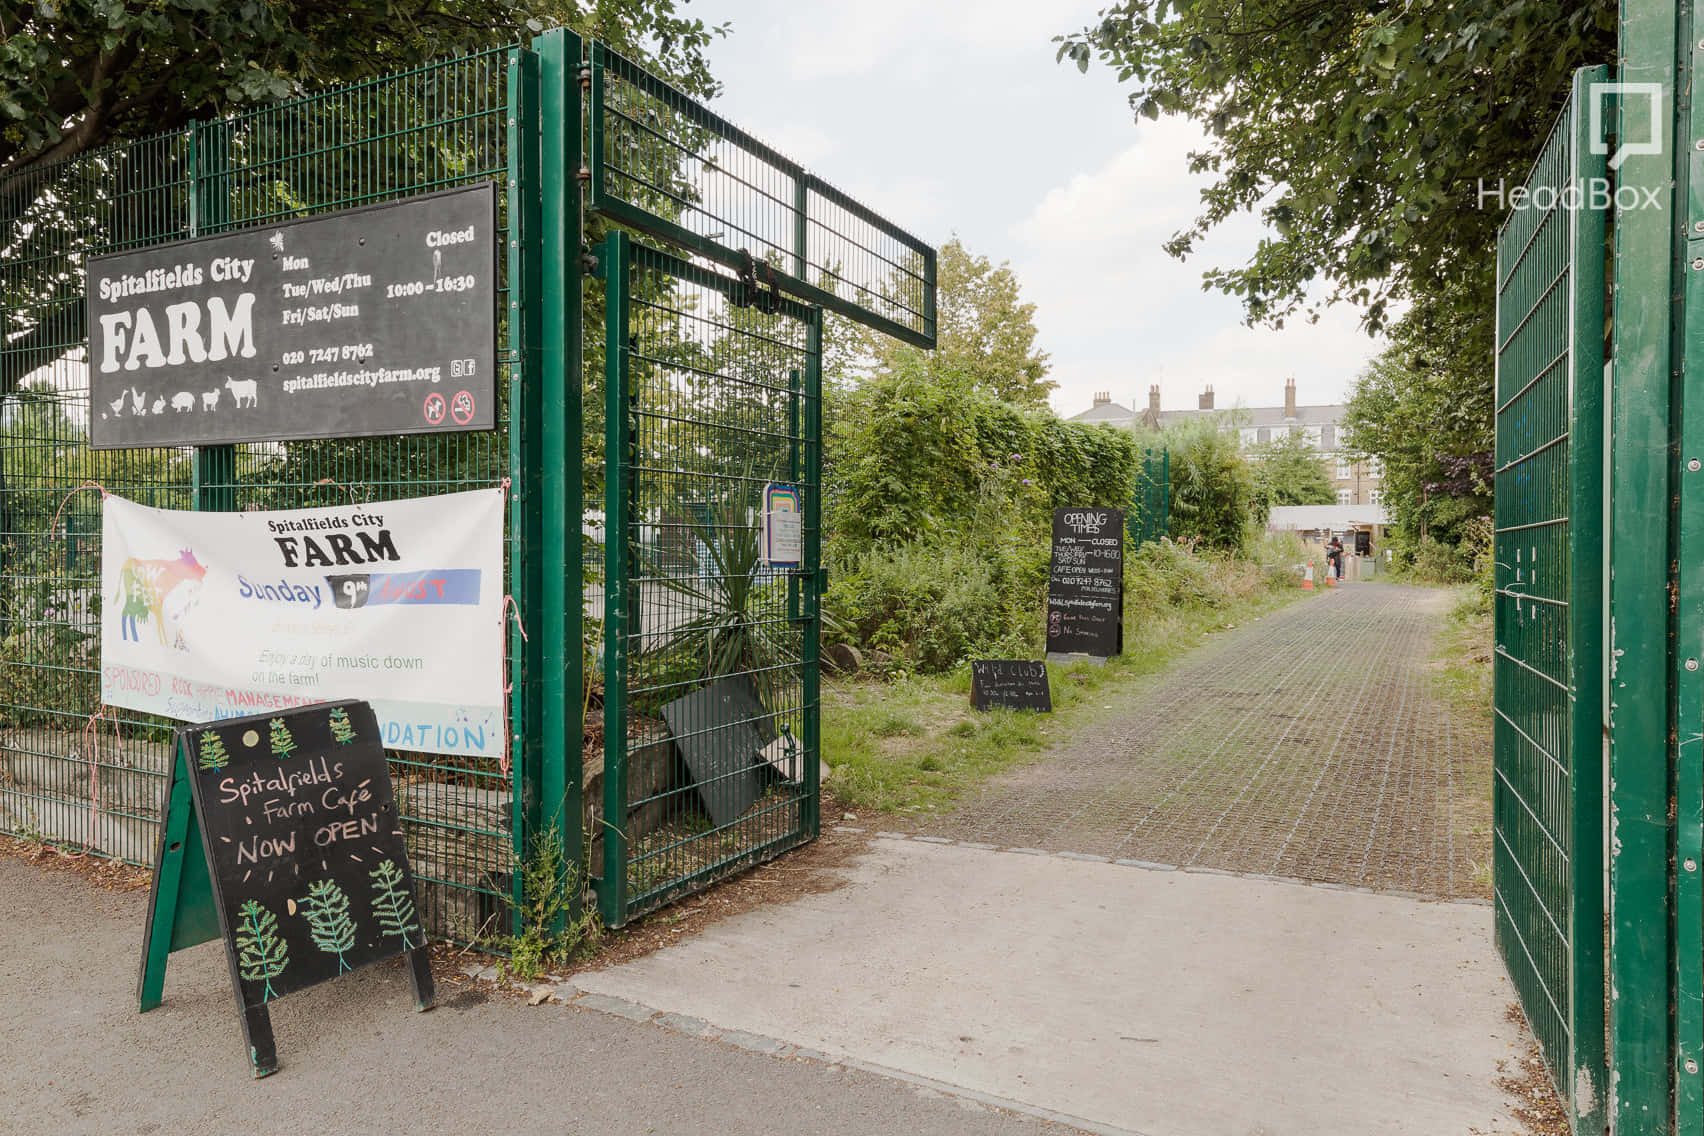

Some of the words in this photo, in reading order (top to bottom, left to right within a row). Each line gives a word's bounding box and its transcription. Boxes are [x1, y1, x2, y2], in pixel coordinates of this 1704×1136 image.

[426, 225, 475, 248] Closed
[282, 256, 310, 272] Mon
[99, 263, 203, 304] Spitalfields
[210, 256, 255, 283] City
[282, 273, 372, 299] Tue/Wed/Thu
[282, 303, 359, 327] Fri/Sat/Sun
[99, 292, 257, 374] FARM
[282, 350, 305, 366] 020
[308, 346, 340, 364] 7247
[341, 343, 374, 361] 8762
[282, 366, 441, 395] spitalfieldscityfarm.org
[267, 516, 349, 534] Spitalfields
[351, 513, 384, 528] City
[1063, 512, 1108, 525] OPENING
[273, 529, 401, 568] FARM
[1091, 538, 1118, 546] CLOSED
[237, 573, 322, 610] Sunday
[320, 652, 333, 668] of
[336, 652, 380, 670] music
[382, 655, 424, 670] down
[219, 756, 344, 806] Spitalfields
[263, 798, 315, 825] Farm
[321, 778, 373, 816] Café
[314, 812, 379, 847] OPEN
